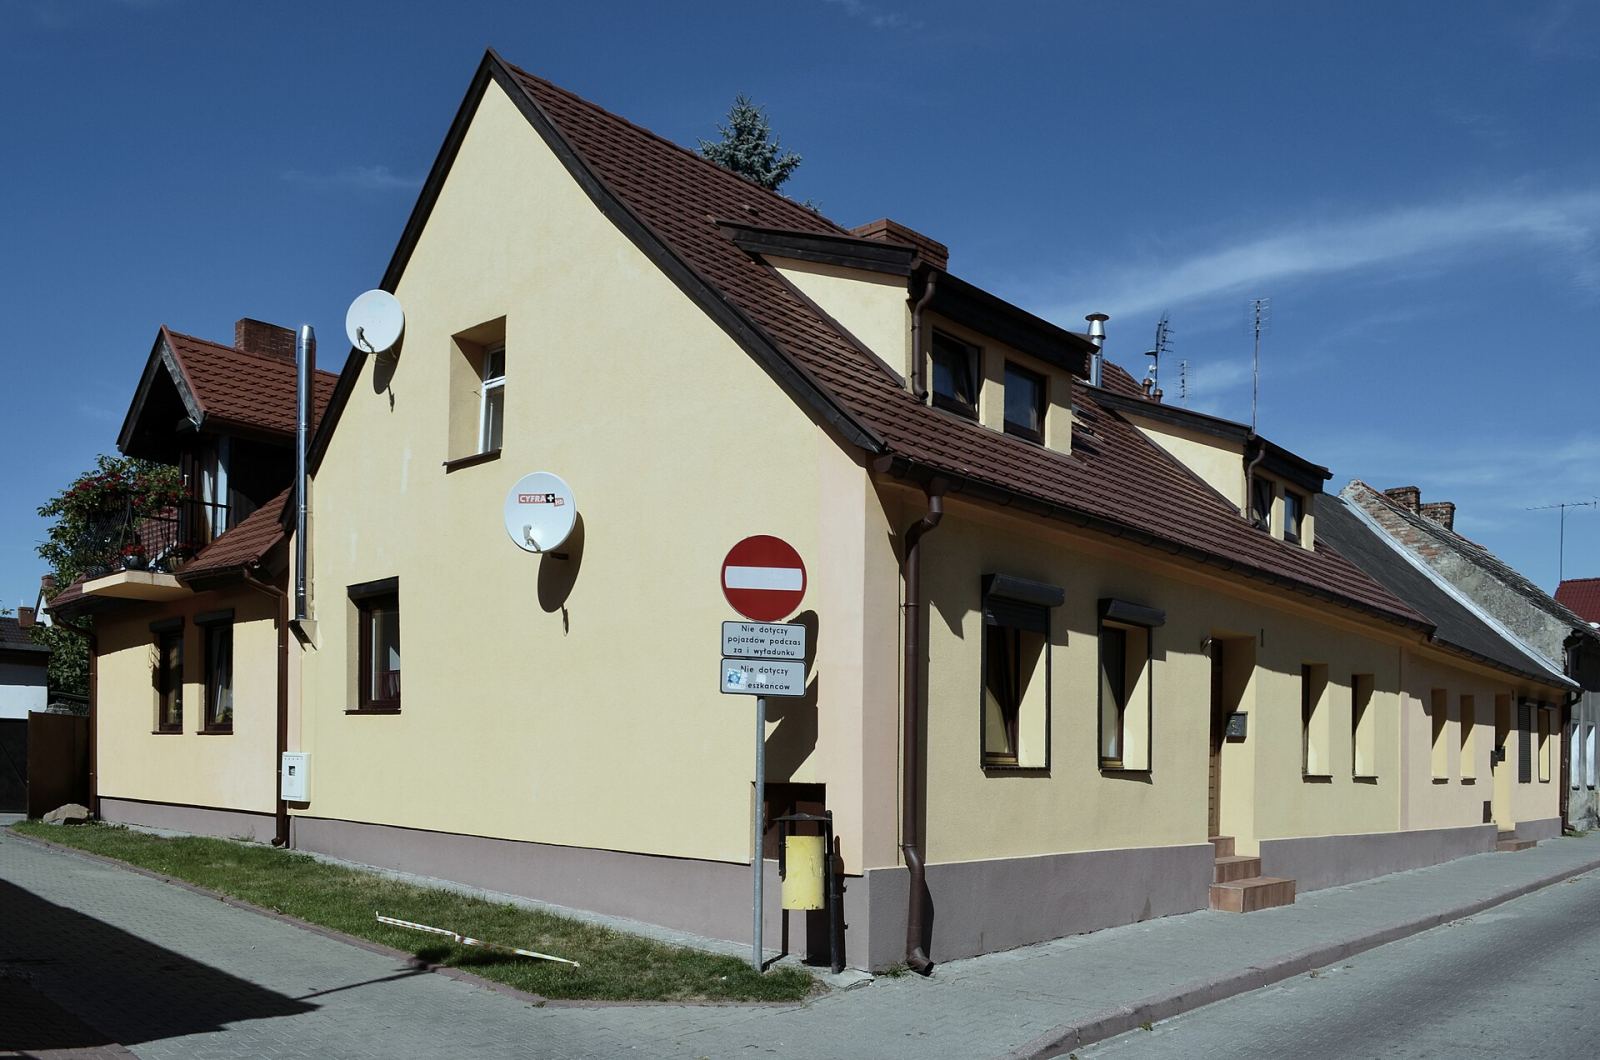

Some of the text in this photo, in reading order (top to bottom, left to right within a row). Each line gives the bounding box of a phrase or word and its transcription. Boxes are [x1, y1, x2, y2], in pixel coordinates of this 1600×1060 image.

[741, 625, 788, 635] Nie dotyczy
[769, 638, 801, 646] podczas
[740, 665, 789, 676] Nie dotyczy
